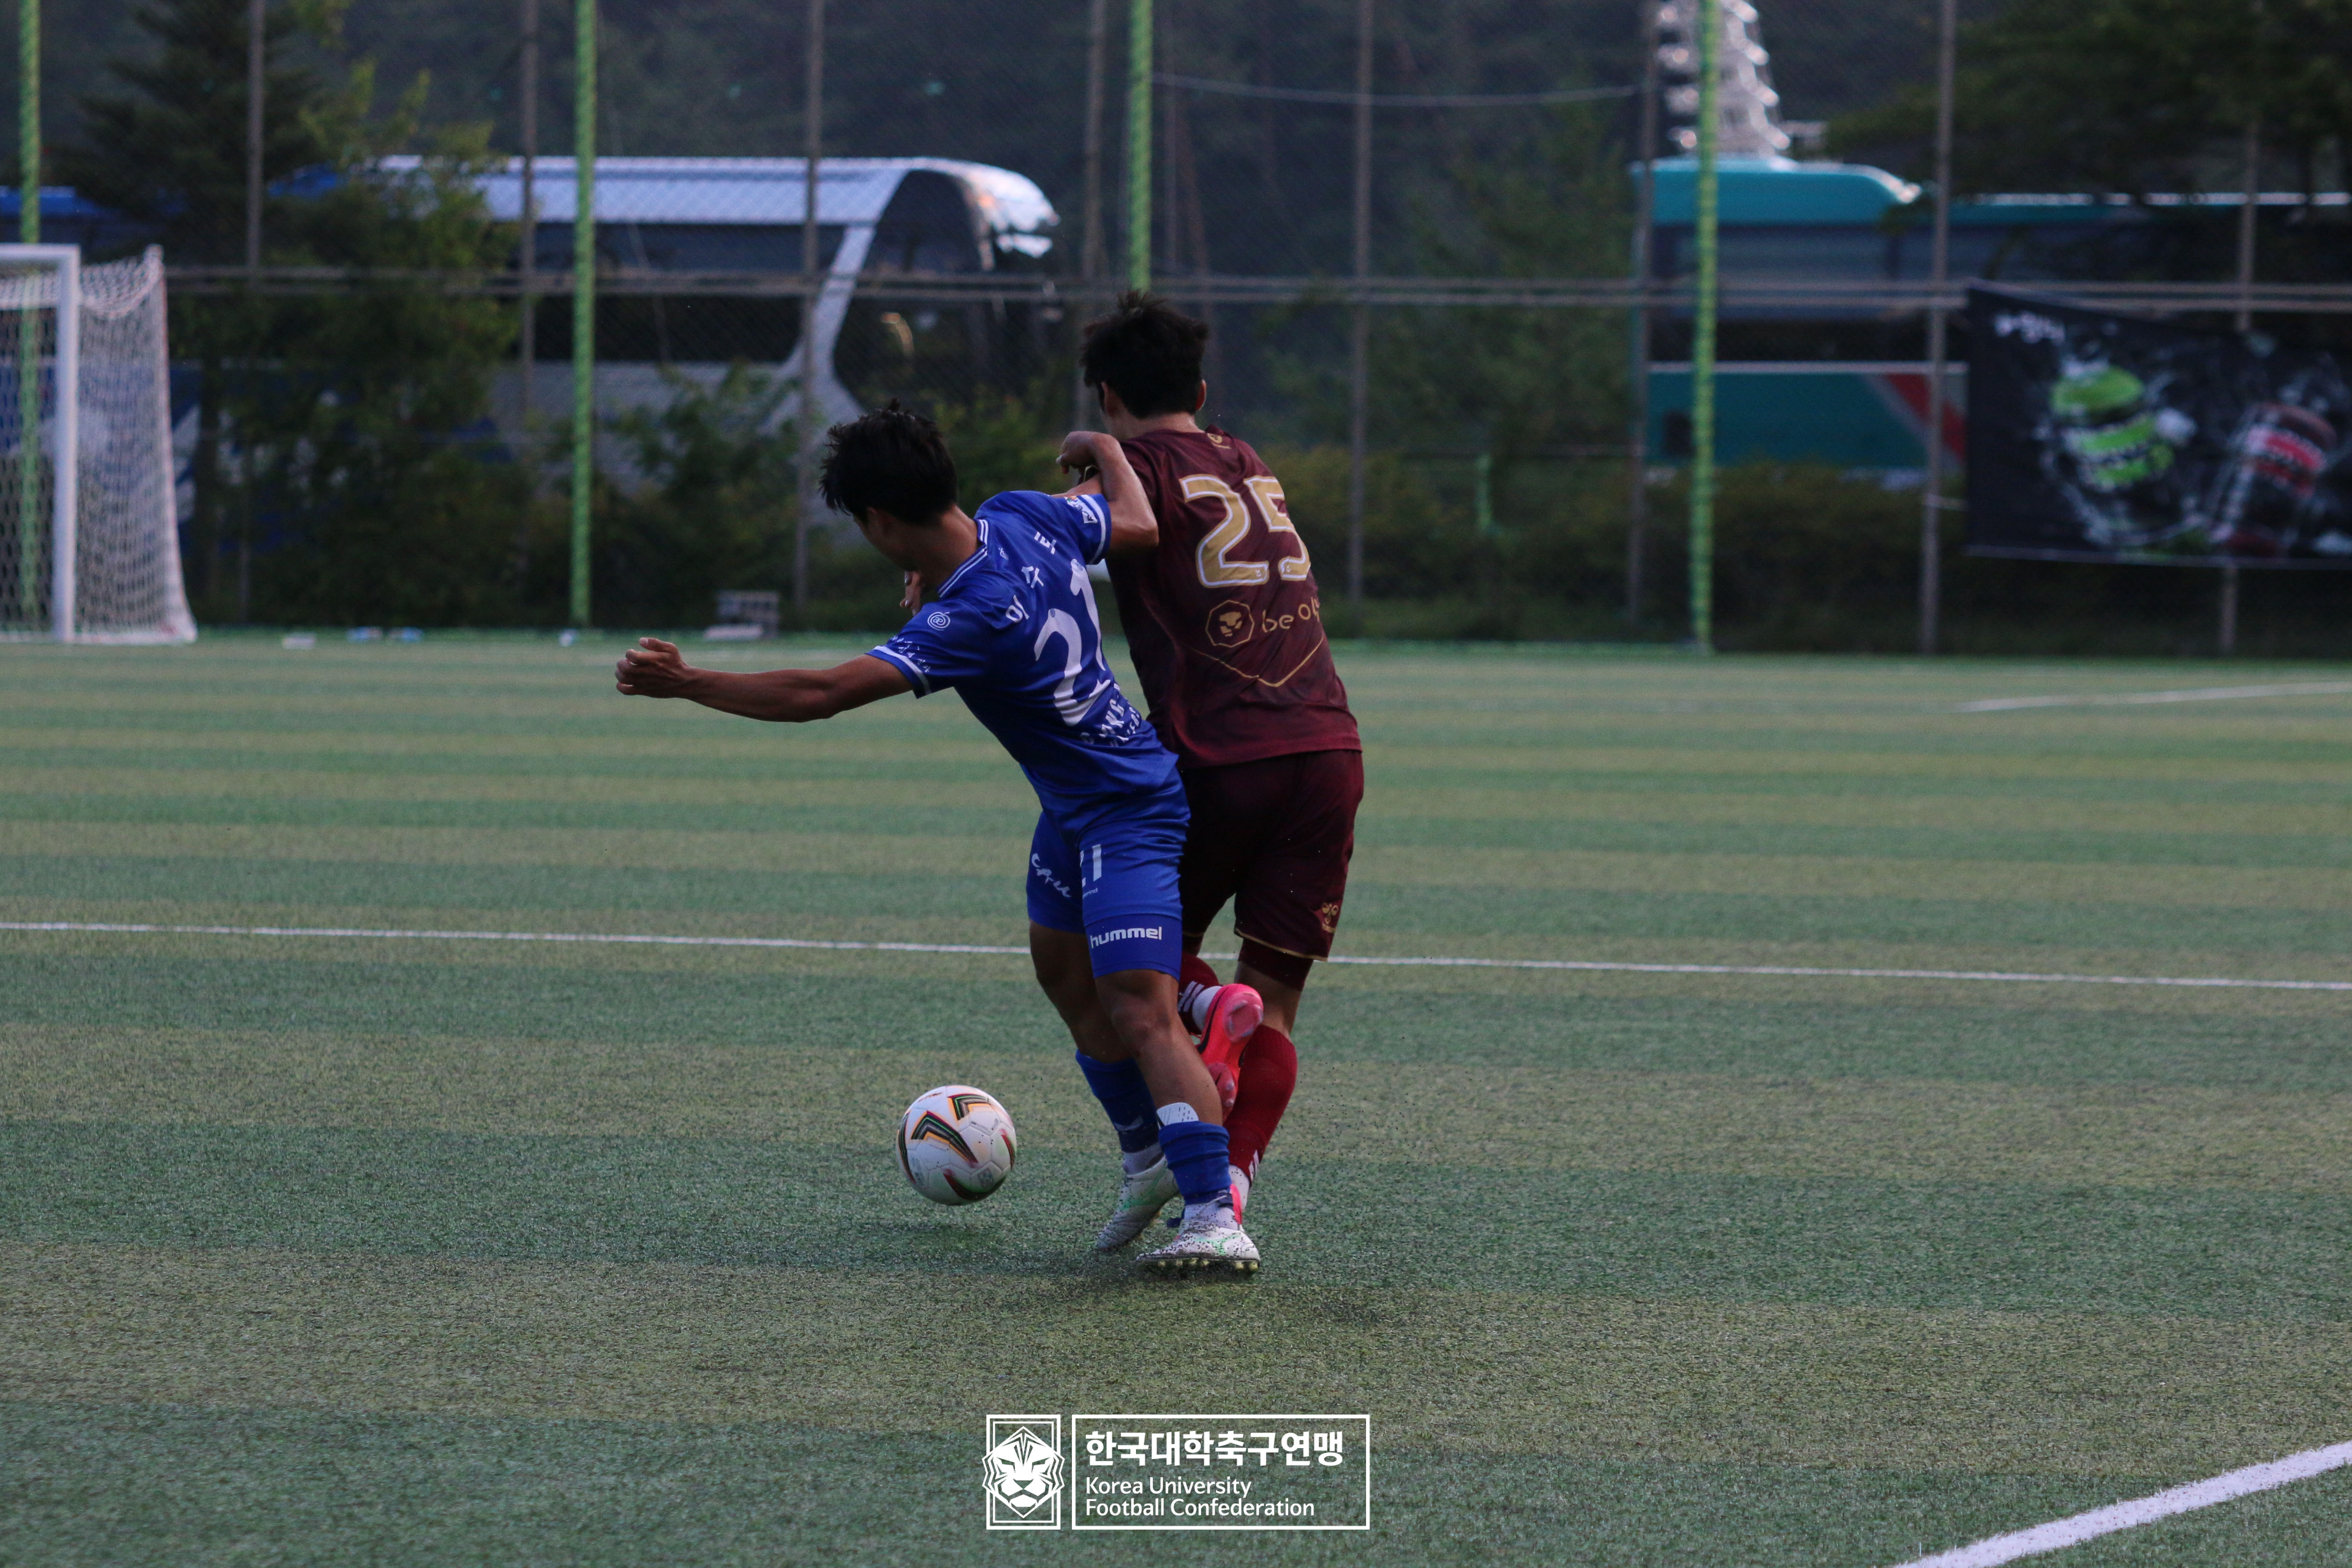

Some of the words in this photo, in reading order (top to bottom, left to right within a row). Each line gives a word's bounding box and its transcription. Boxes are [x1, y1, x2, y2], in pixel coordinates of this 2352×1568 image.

[1179, 474, 1311, 588] 25
[1034, 558, 1111, 726] 21
[1079, 844, 1102, 887] 1
[1090, 926, 1162, 949] hummel
